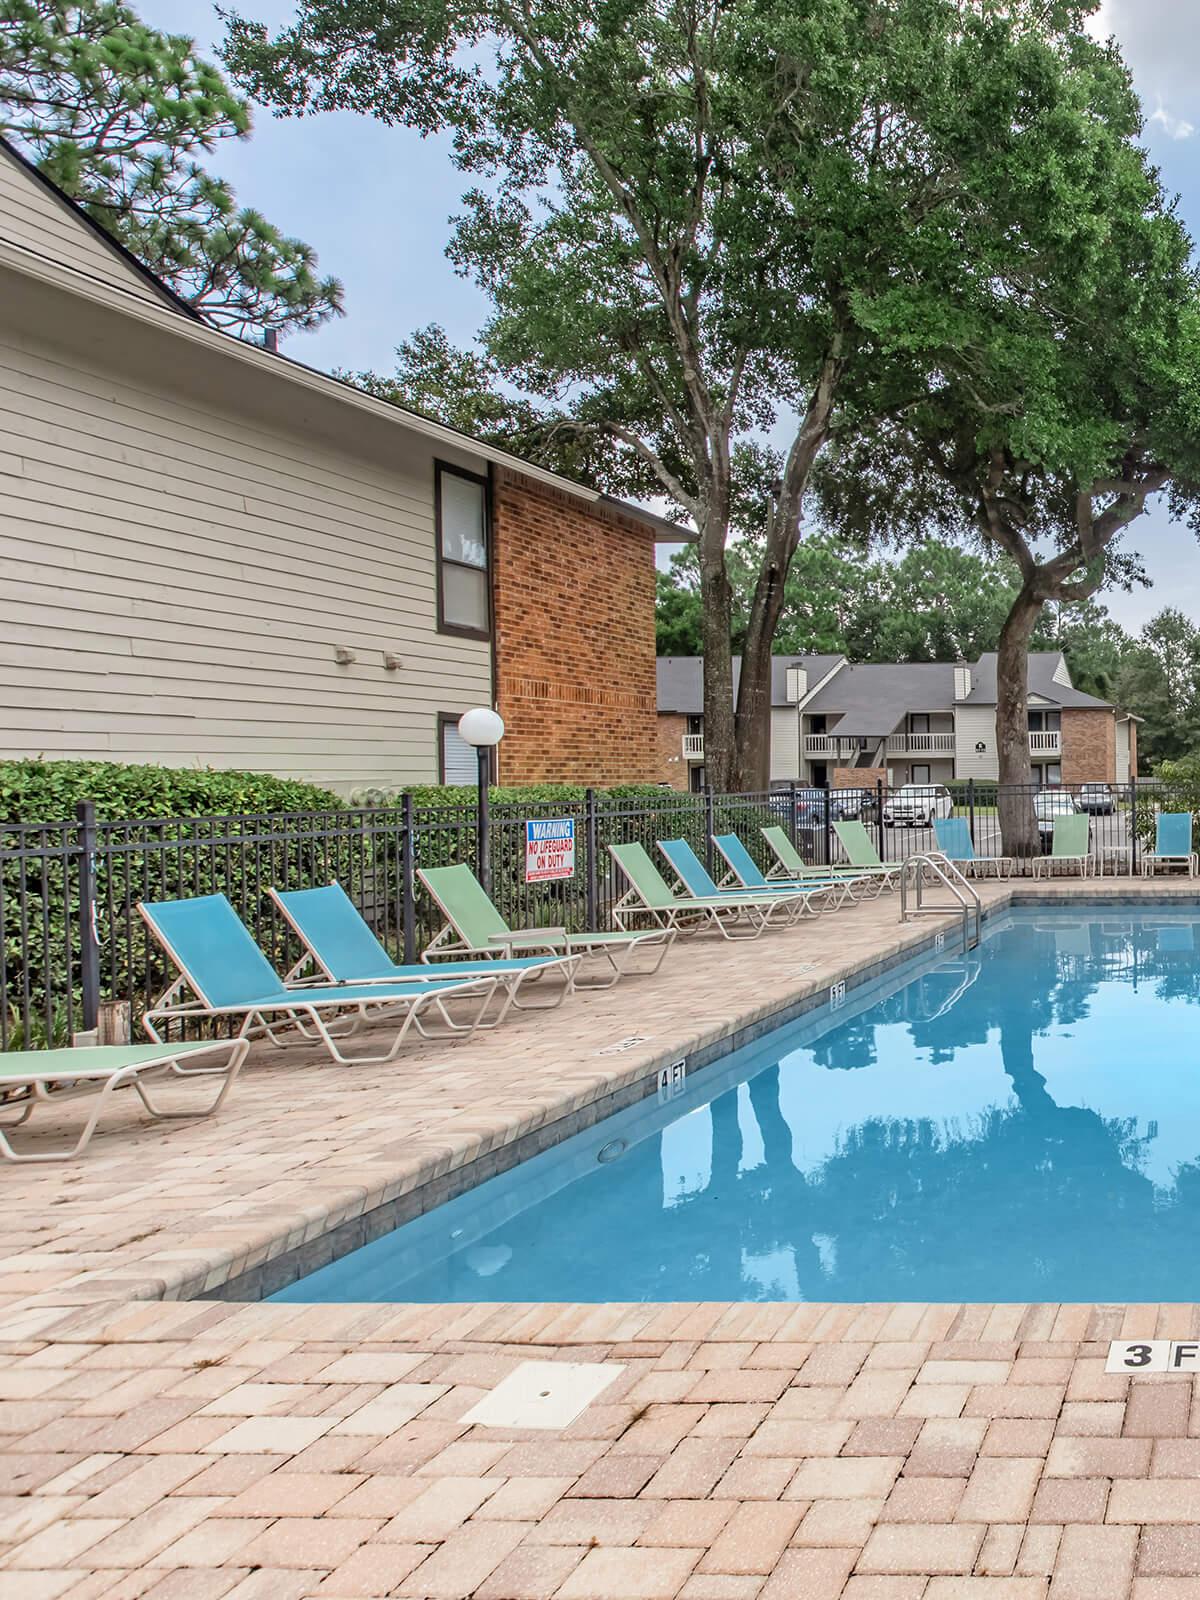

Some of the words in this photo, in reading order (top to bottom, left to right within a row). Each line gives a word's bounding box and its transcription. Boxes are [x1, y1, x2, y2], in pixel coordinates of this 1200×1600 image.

[532, 822, 570, 839] WARNING
[529, 841, 538, 855] NO
[540, 839, 573, 854] LIFEGUARD
[537, 856, 546, 869] ON
[548, 854, 564, 868] DUTY
[661, 1070, 668, 1087] 4
[673, 1062, 684, 1083] FT
[1124, 1344, 1153, 1367] 3
